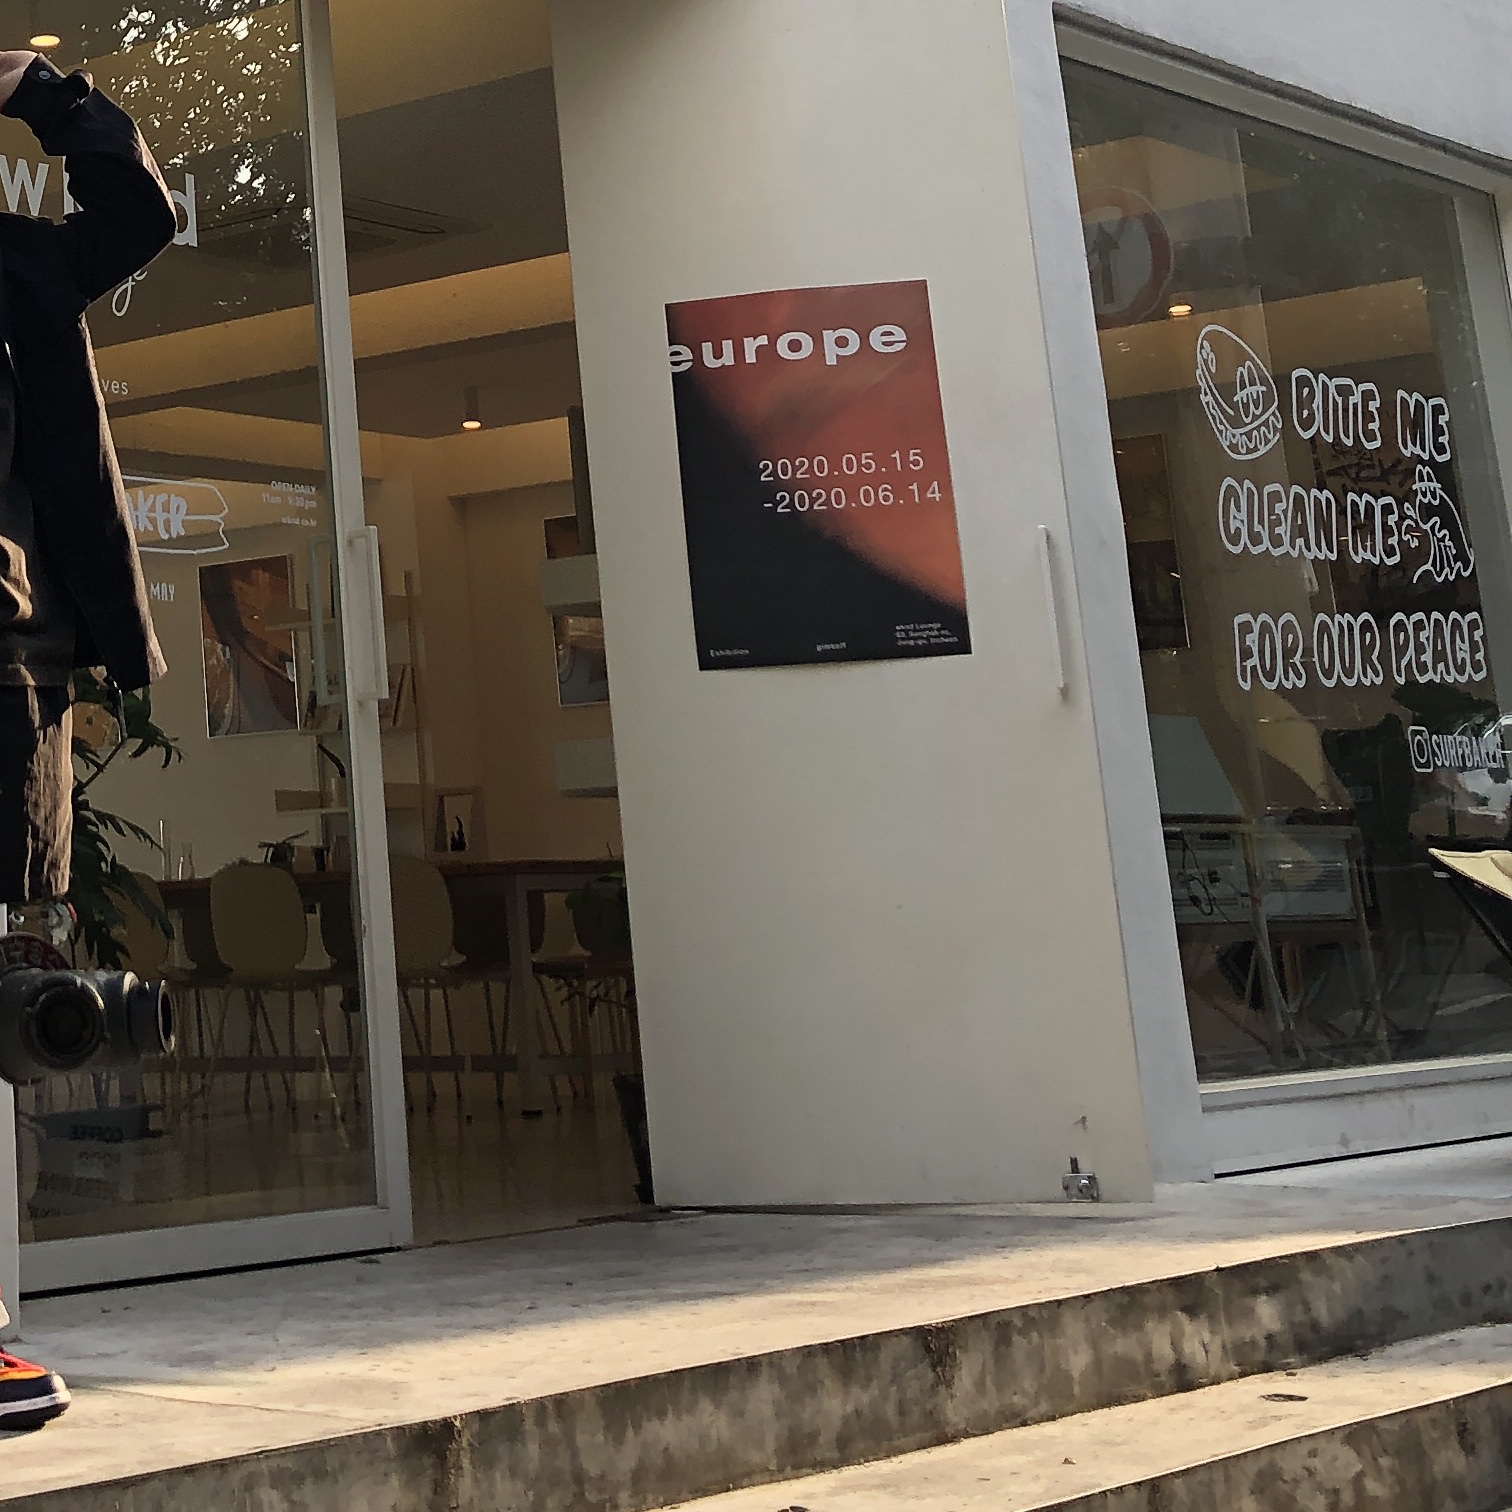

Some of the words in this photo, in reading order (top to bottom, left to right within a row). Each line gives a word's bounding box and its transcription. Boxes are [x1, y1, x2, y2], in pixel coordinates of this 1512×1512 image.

[668, 324, 908, 372] europe
[1292, 368, 1381, 449] BITE
[1397, 389, 1451, 462] ME
[758, 449, 925, 481] 2020.05.15
[763, 481, 942, 513] -2020.06.14
[1218, 476, 1338, 561] CLEAN
[1347, 492, 1401, 565] ME
[150, 582, 175, 602] MAY
[1234, 612, 1306, 691] FOR
[1313, 611, 1384, 688] OUR
[1390, 610, 1487, 685] PEACE
